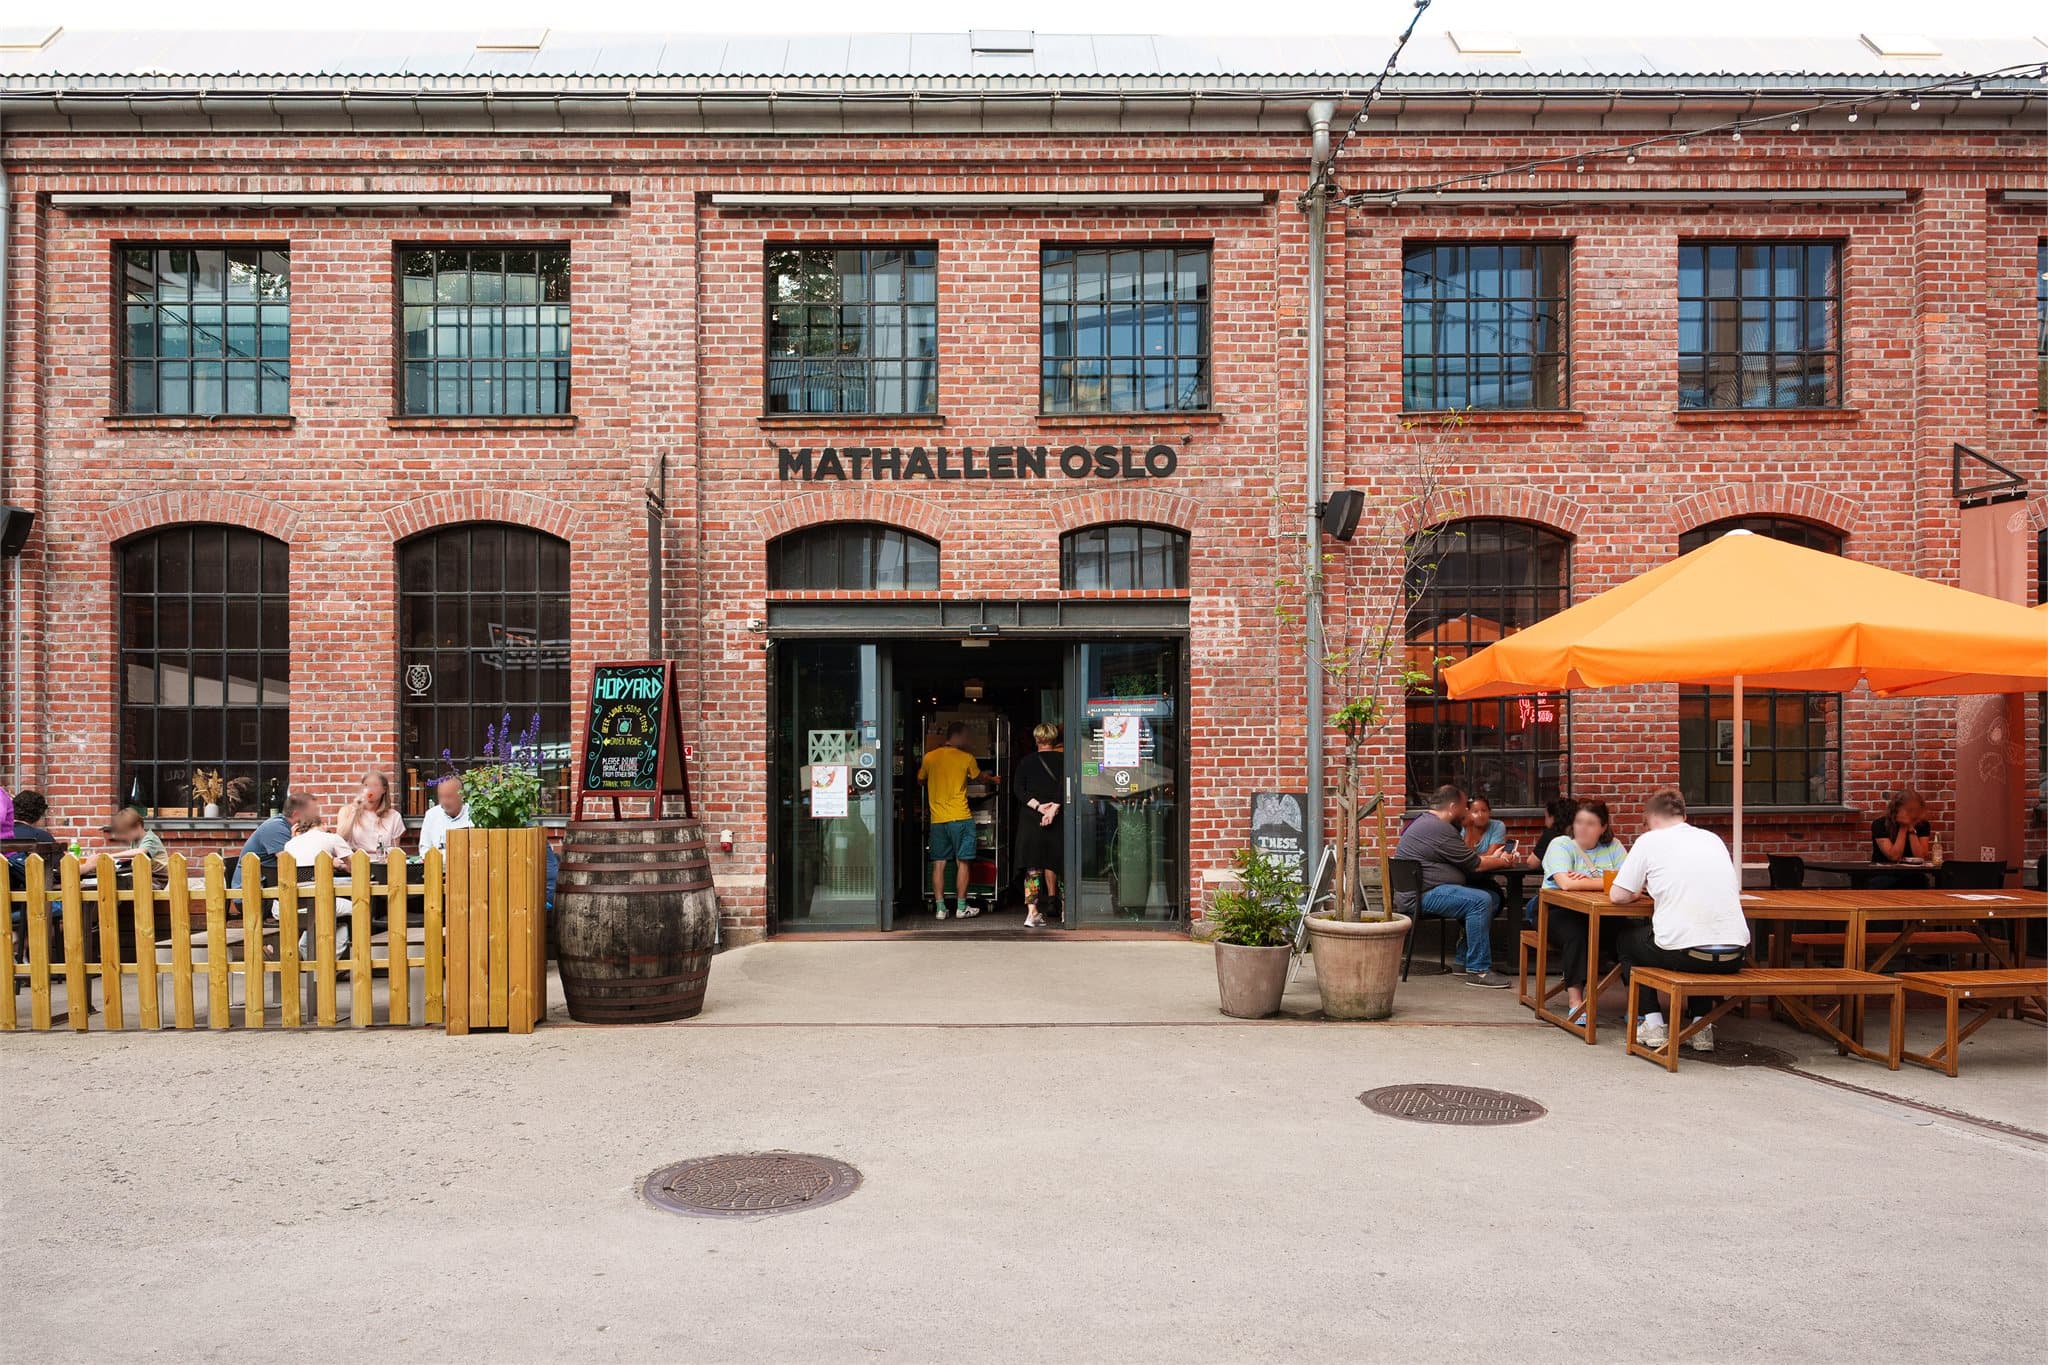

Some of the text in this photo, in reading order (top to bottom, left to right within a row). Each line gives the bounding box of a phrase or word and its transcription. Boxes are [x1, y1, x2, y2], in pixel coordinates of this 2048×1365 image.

[778, 445, 1178, 481] MATHALLEN OSLO
[595, 677, 663, 699] HOPYARD
[1258, 836, 1297, 849] THESE
